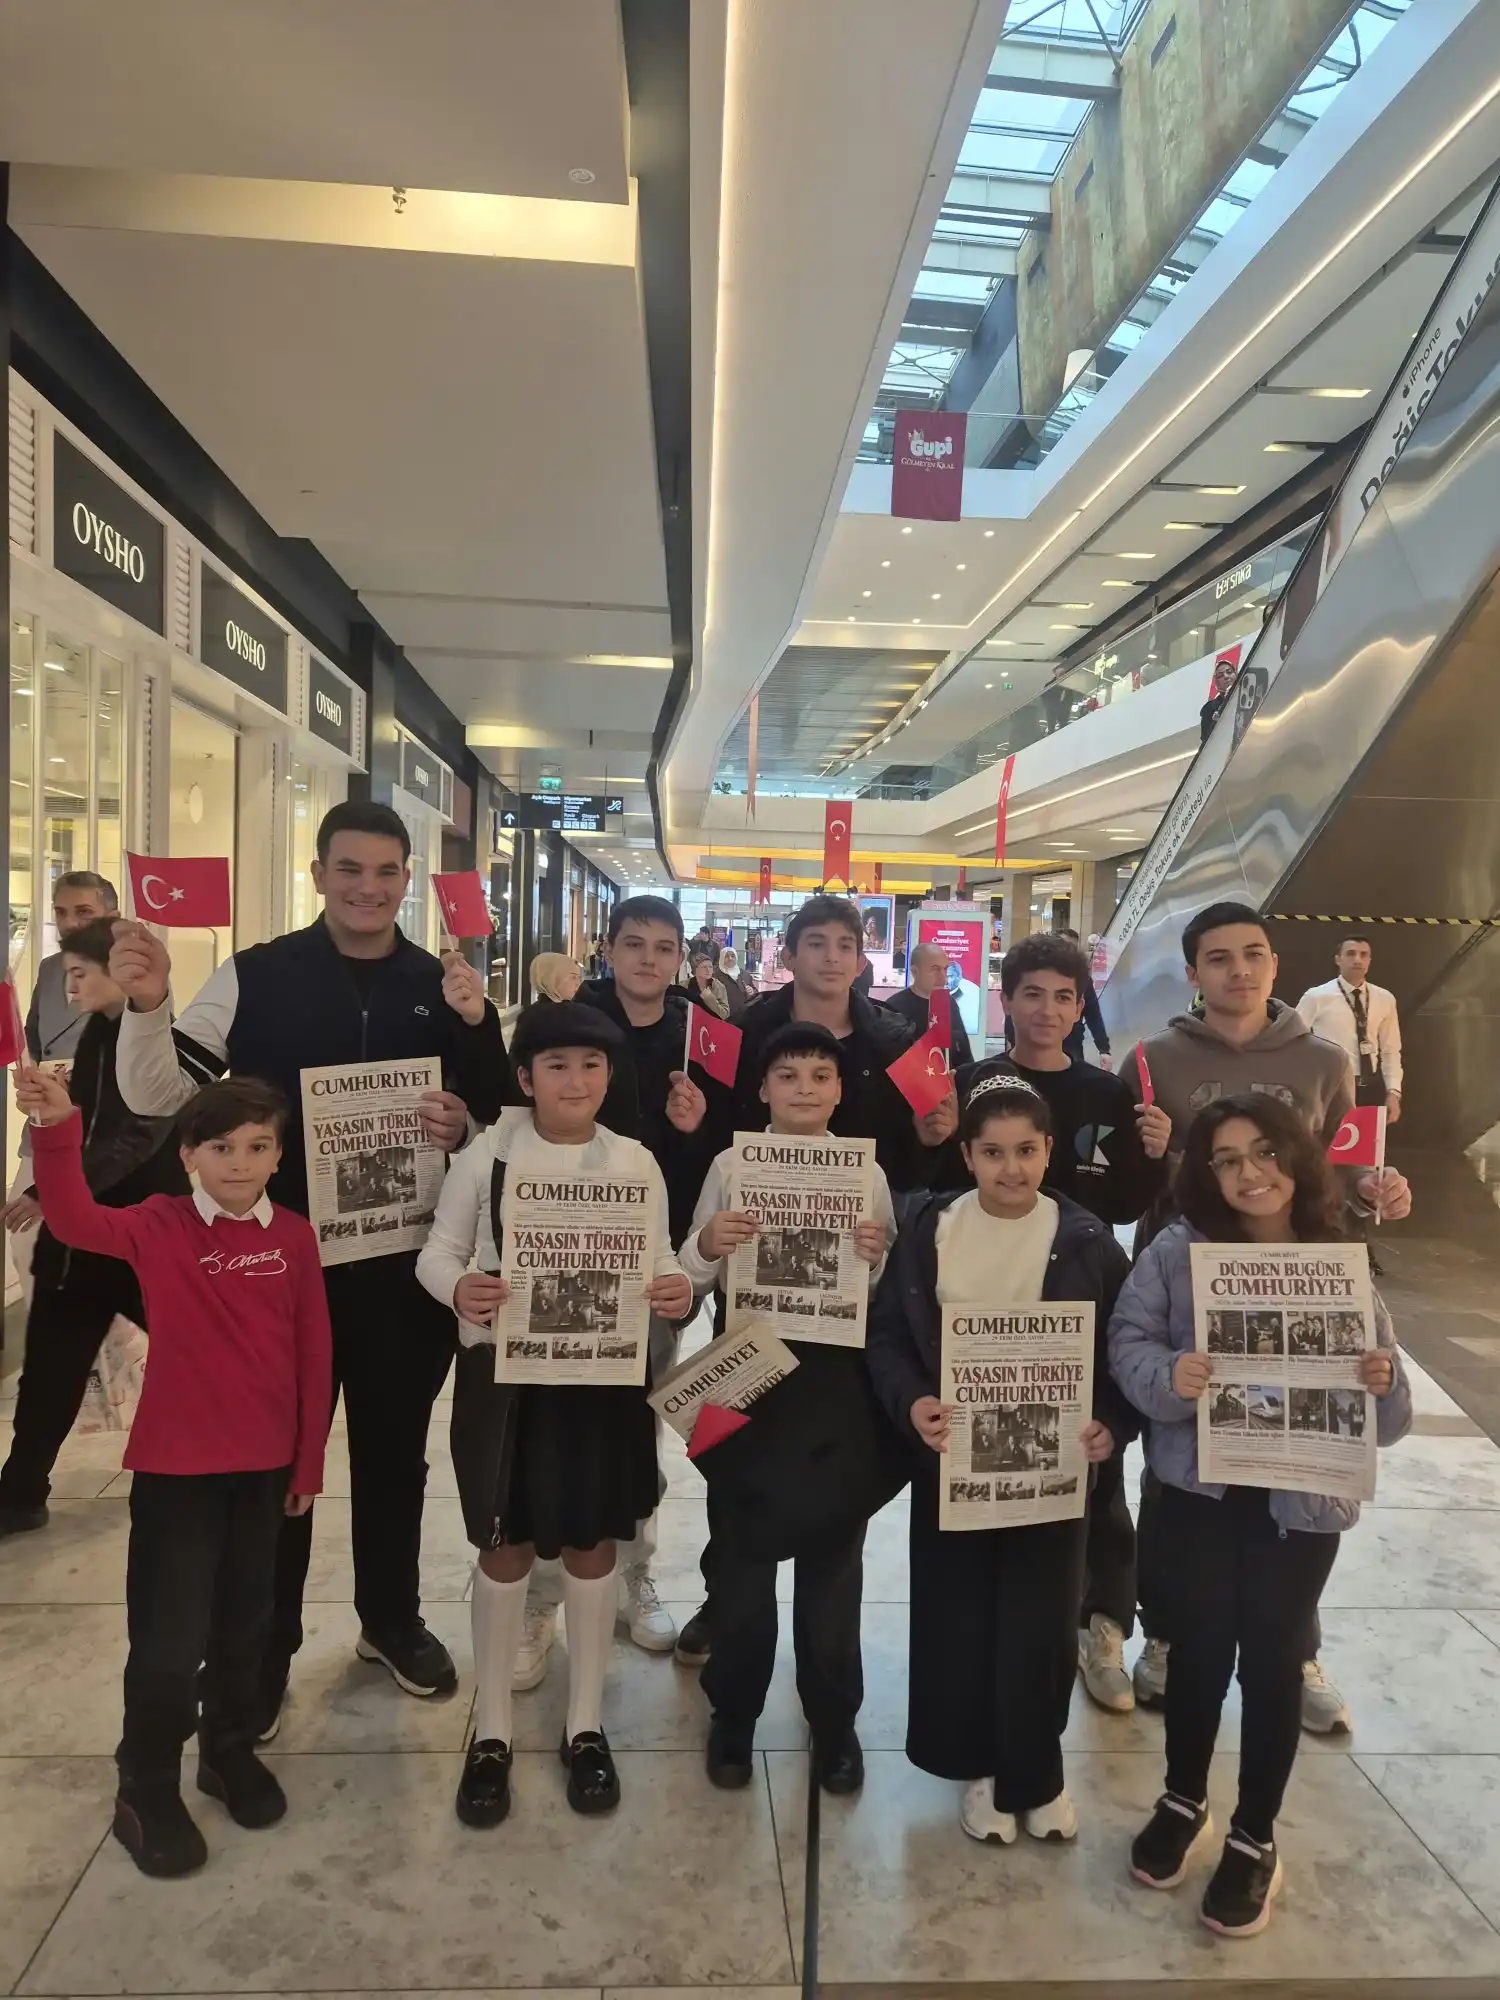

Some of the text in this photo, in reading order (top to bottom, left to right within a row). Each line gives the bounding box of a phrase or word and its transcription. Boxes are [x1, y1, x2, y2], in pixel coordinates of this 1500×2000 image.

[1408, 327, 1441, 387] iPhone
[910, 436, 953, 460] Gupi
[72, 502, 144, 583] OYSHO
[225, 620, 266, 671] OYSHO
[316, 690, 341, 727] OYSHO
[1180, 794, 1204, 832] desteği
[311, 1070, 432, 1096] CUMHURİYET
[313, 1116, 374, 1140] YAŞASIN
[377, 1110, 421, 1132] TÜRKİ
[319, 1127, 430, 1155] CUMHURİYETİ!
[742, 1145, 865, 1168] CUMHURİYET
[515, 1182, 649, 1203] CUMHURİYET
[740, 1190, 864, 1213] YAŞASIN TÜRKİYE
[513, 1231, 647, 1251] YAŞASIN TÜRKİYE
[516, 1250, 639, 1270] CUMHURİYETİ!
[1219, 1261, 1346, 1276] DÜNDEN BUGÜNE
[1210, 1277, 1355, 1296] CUMHURİYET
[952, 1314, 1084, 1335] CUMHURİYET
[663, 1340, 760, 1414] CUMHURİYET
[951, 1362, 1083, 1386] YAŞASIN TÜRKİYE
[955, 1383, 1077, 1403] CUMHURİYETİ!
